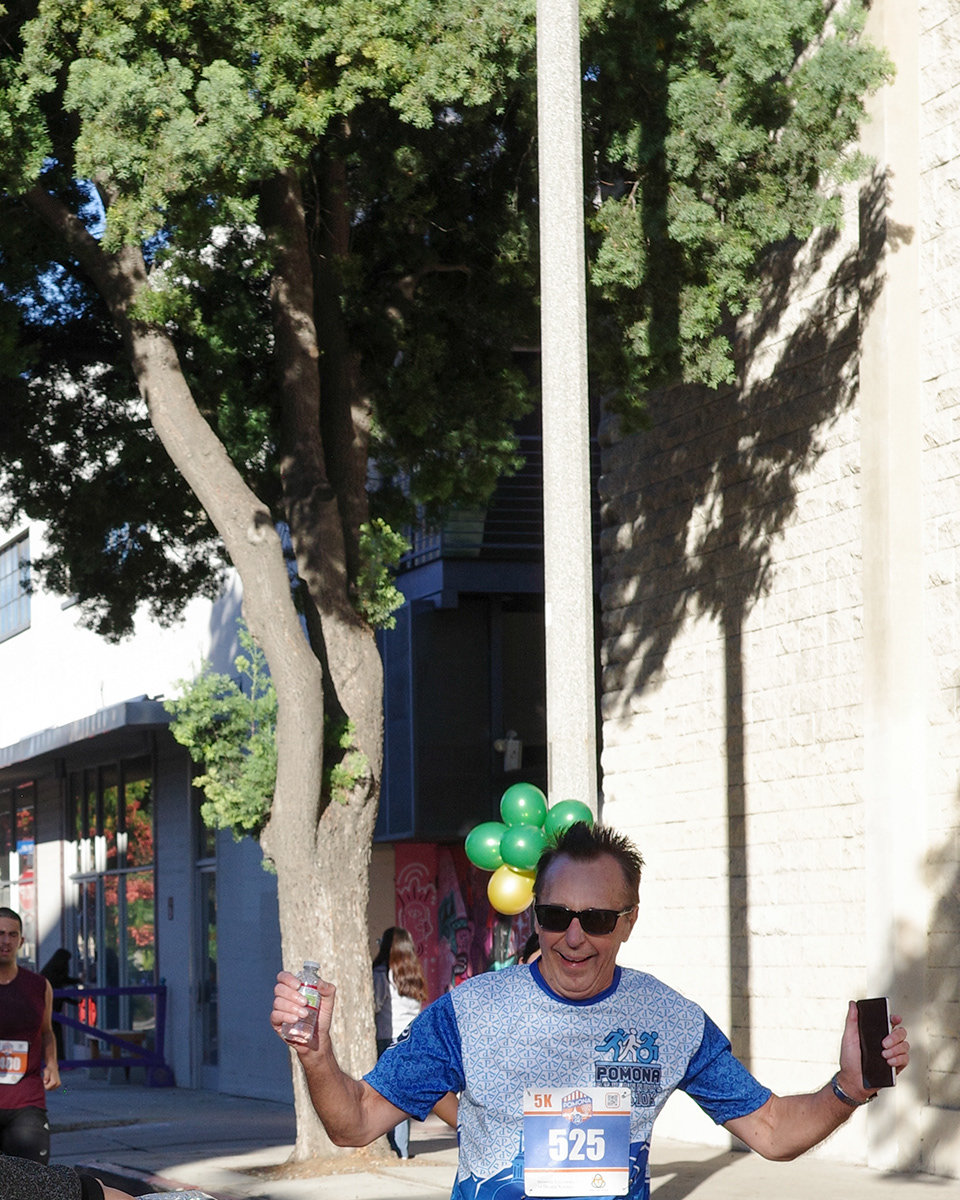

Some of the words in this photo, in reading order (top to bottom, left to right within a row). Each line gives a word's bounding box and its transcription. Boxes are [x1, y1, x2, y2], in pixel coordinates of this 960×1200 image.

[596, 1066, 660, 1083] POMONA
[534, 1094, 552, 1108] 5K
[563, 1097, 592, 1109] POMONA
[548, 1128, 605, 1161] 525
